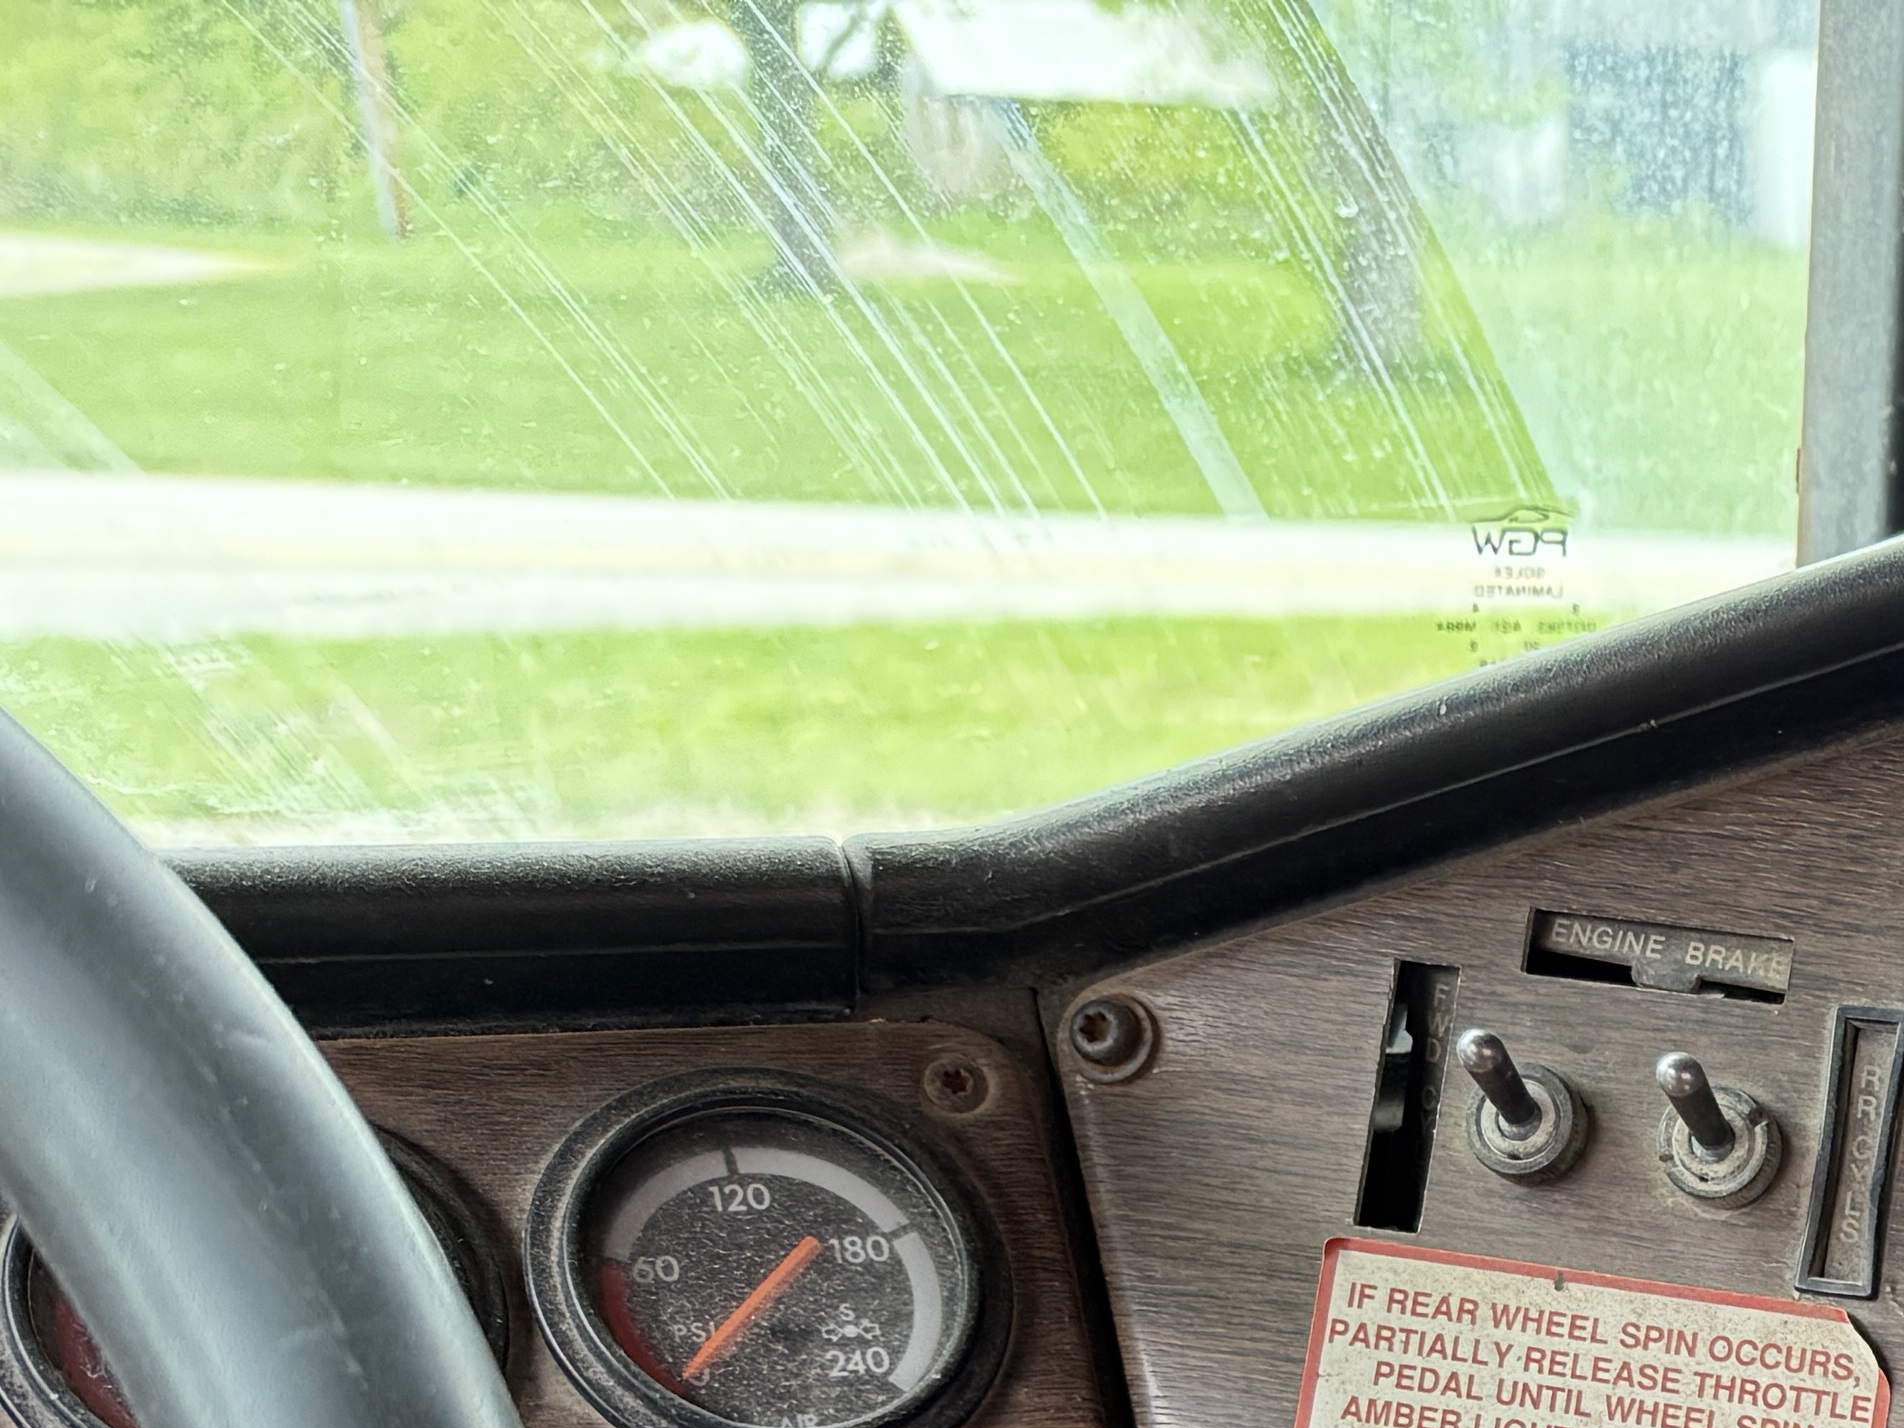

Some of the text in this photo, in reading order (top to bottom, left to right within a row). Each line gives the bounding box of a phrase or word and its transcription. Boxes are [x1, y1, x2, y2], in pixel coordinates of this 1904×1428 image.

[1552, 918, 1790, 980] ENGINE BRAKE
[709, 1183, 772, 1213] 120
[631, 1255, 681, 1283] 60
[828, 1235, 891, 1264] 180
[1347, 1282, 1862, 1388] IF REAR WHEEL SPIN OCCURS,
[824, 1346, 891, 1378] 240
[1328, 1318, 1872, 1424] PARTIALLY RELEASE THROTTLE
[1373, 1360, 1484, 1401] PEDAL
[1496, 1378, 1592, 1418] UNTIL
